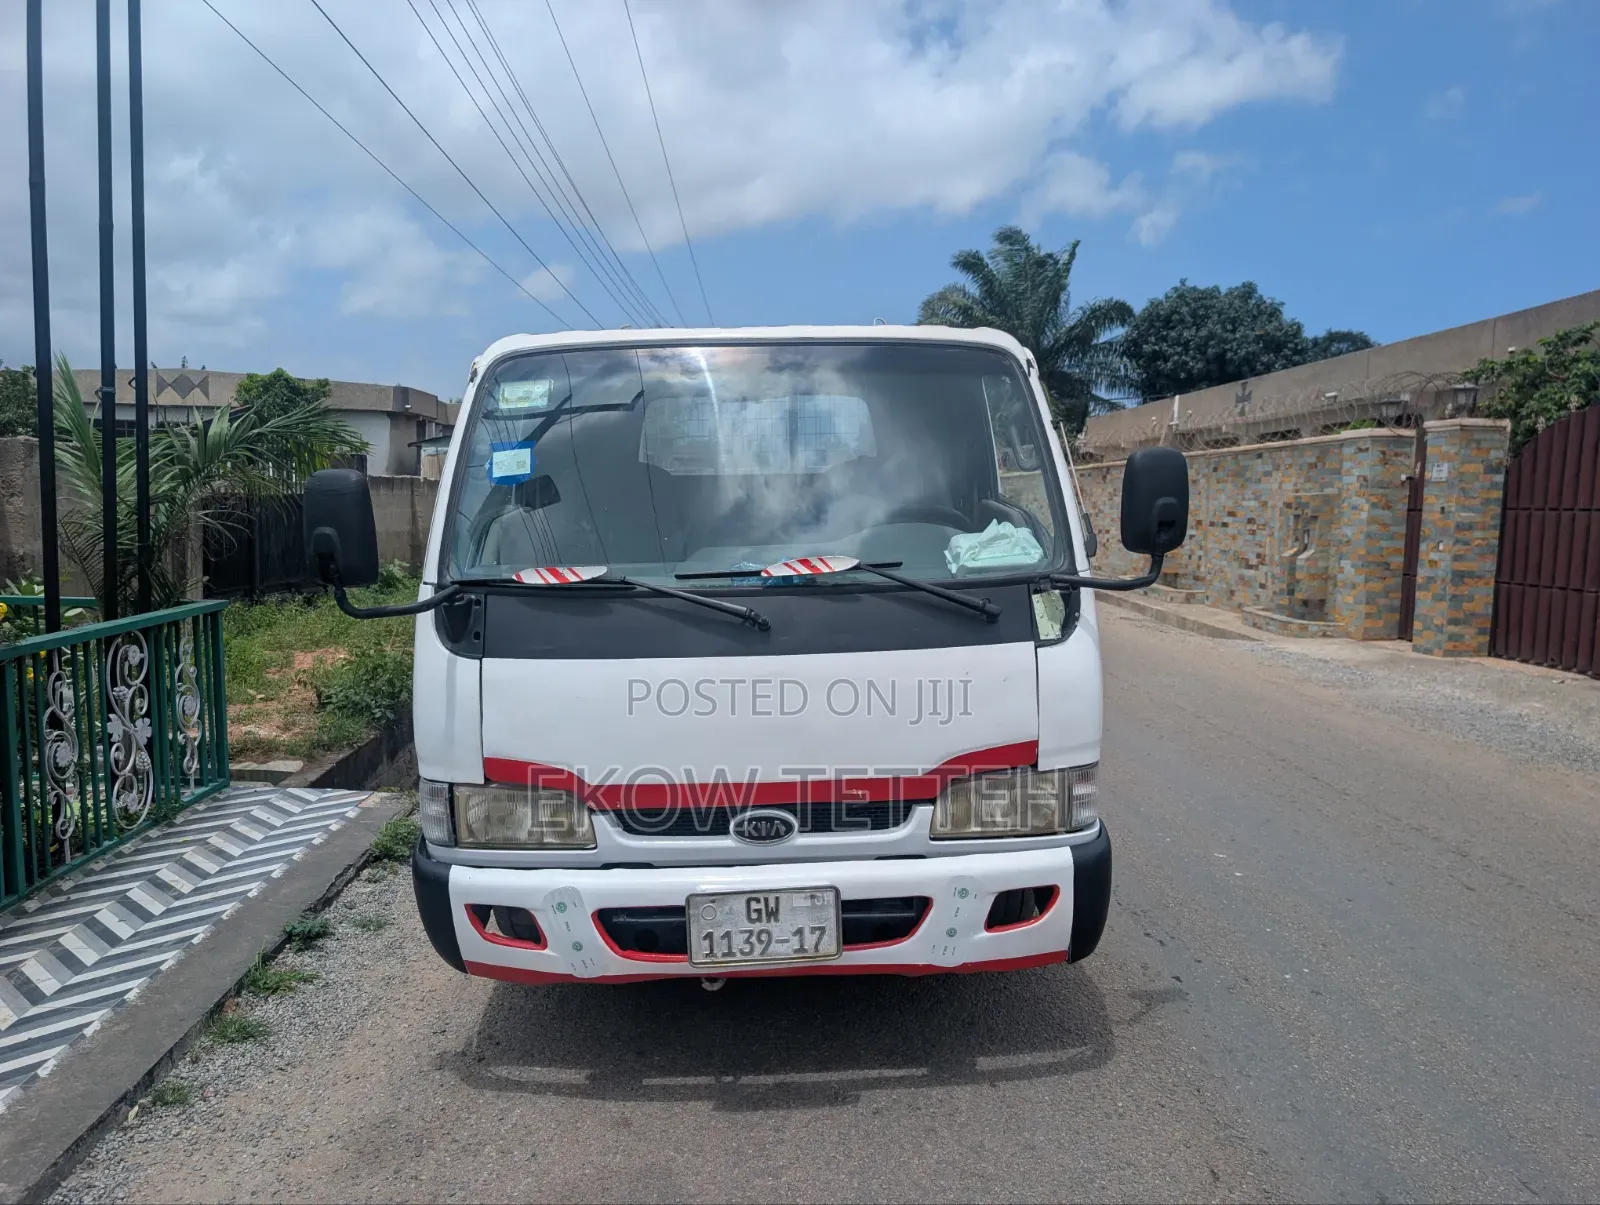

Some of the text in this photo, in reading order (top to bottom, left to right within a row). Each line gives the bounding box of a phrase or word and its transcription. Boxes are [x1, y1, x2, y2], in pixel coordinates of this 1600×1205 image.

[743, 820, 787, 838] KIA
[745, 895, 781, 925] GW
[701, 924, 828, 959] 1139-17
